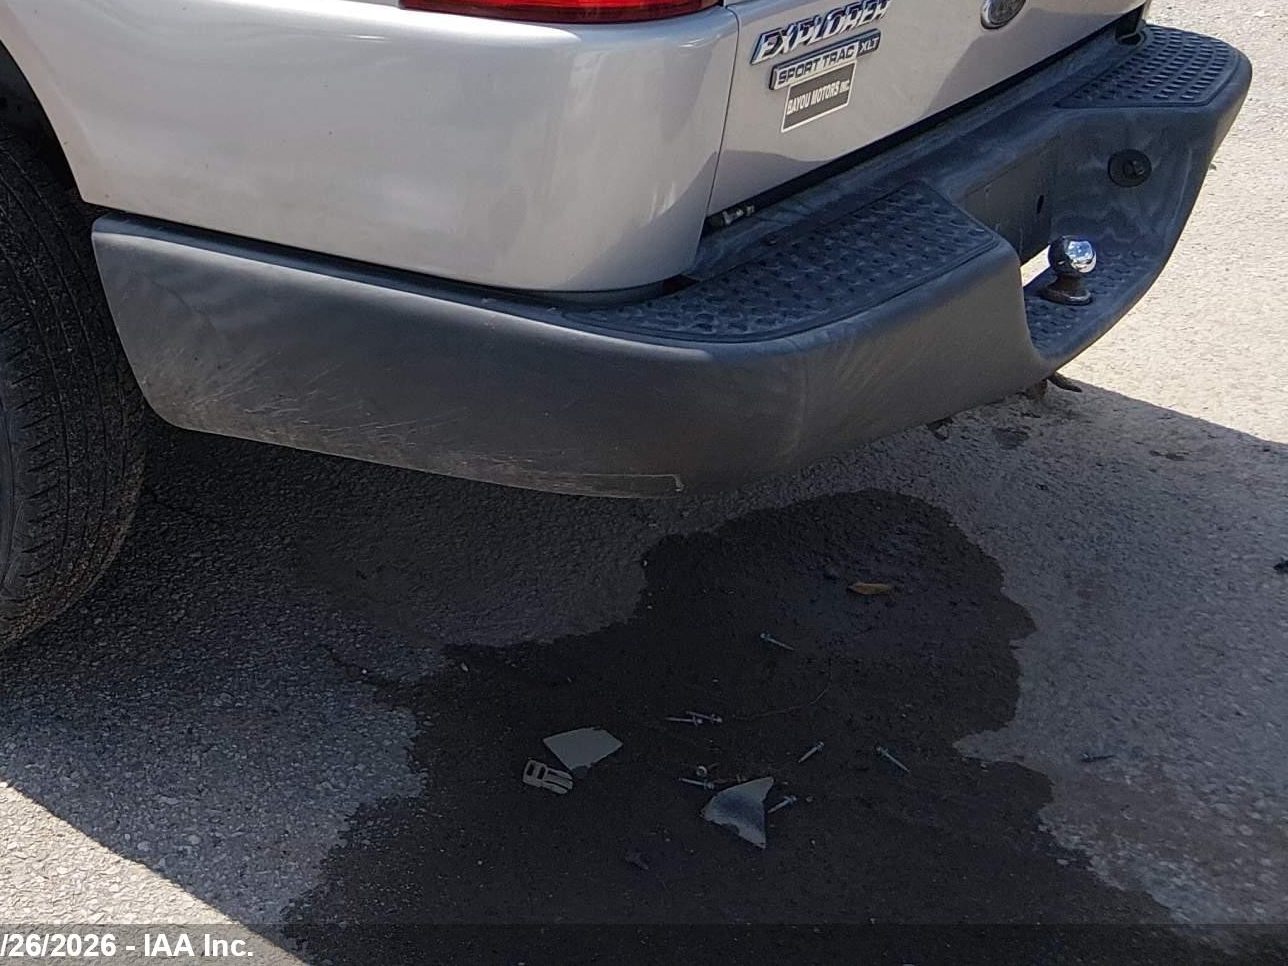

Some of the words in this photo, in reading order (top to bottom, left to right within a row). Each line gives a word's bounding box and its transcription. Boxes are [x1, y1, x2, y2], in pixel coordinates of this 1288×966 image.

[778, 60, 820, 85] SPORT
[823, 46, 855, 66] TRAC
[860, 37, 880, 54] XLT
[786, 92, 811, 115] BAYOU
[811, 81, 840, 105] MOTORS
